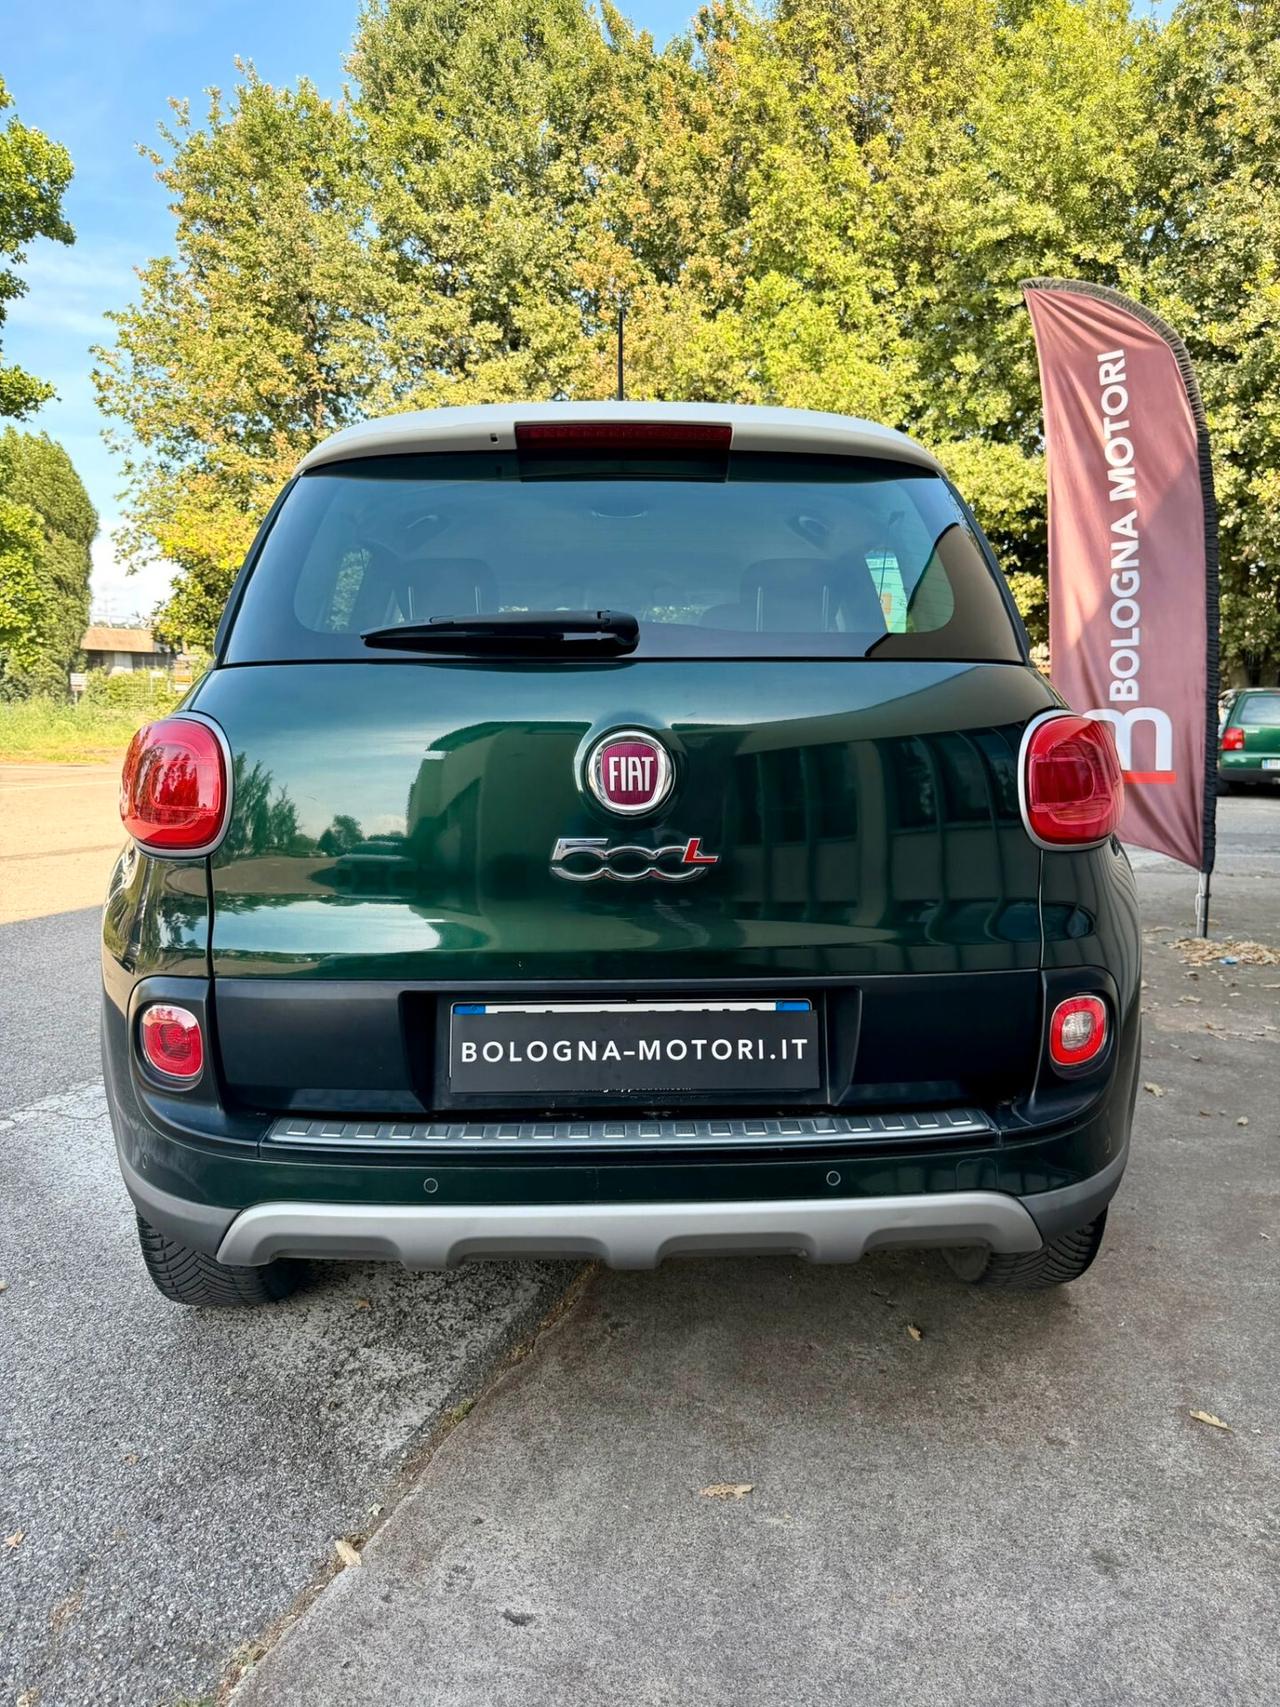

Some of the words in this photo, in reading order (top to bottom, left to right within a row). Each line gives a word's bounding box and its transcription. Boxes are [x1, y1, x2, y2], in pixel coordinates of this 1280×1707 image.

[1096, 349, 1137, 502] MOTORI
[1109, 509, 1141, 702] BOLOGNA
[608, 756, 655, 792] FIAT
[551, 837, 719, 882] 500L
[461, 1039, 808, 1063] BOLOGNA-MOTORI.IT
